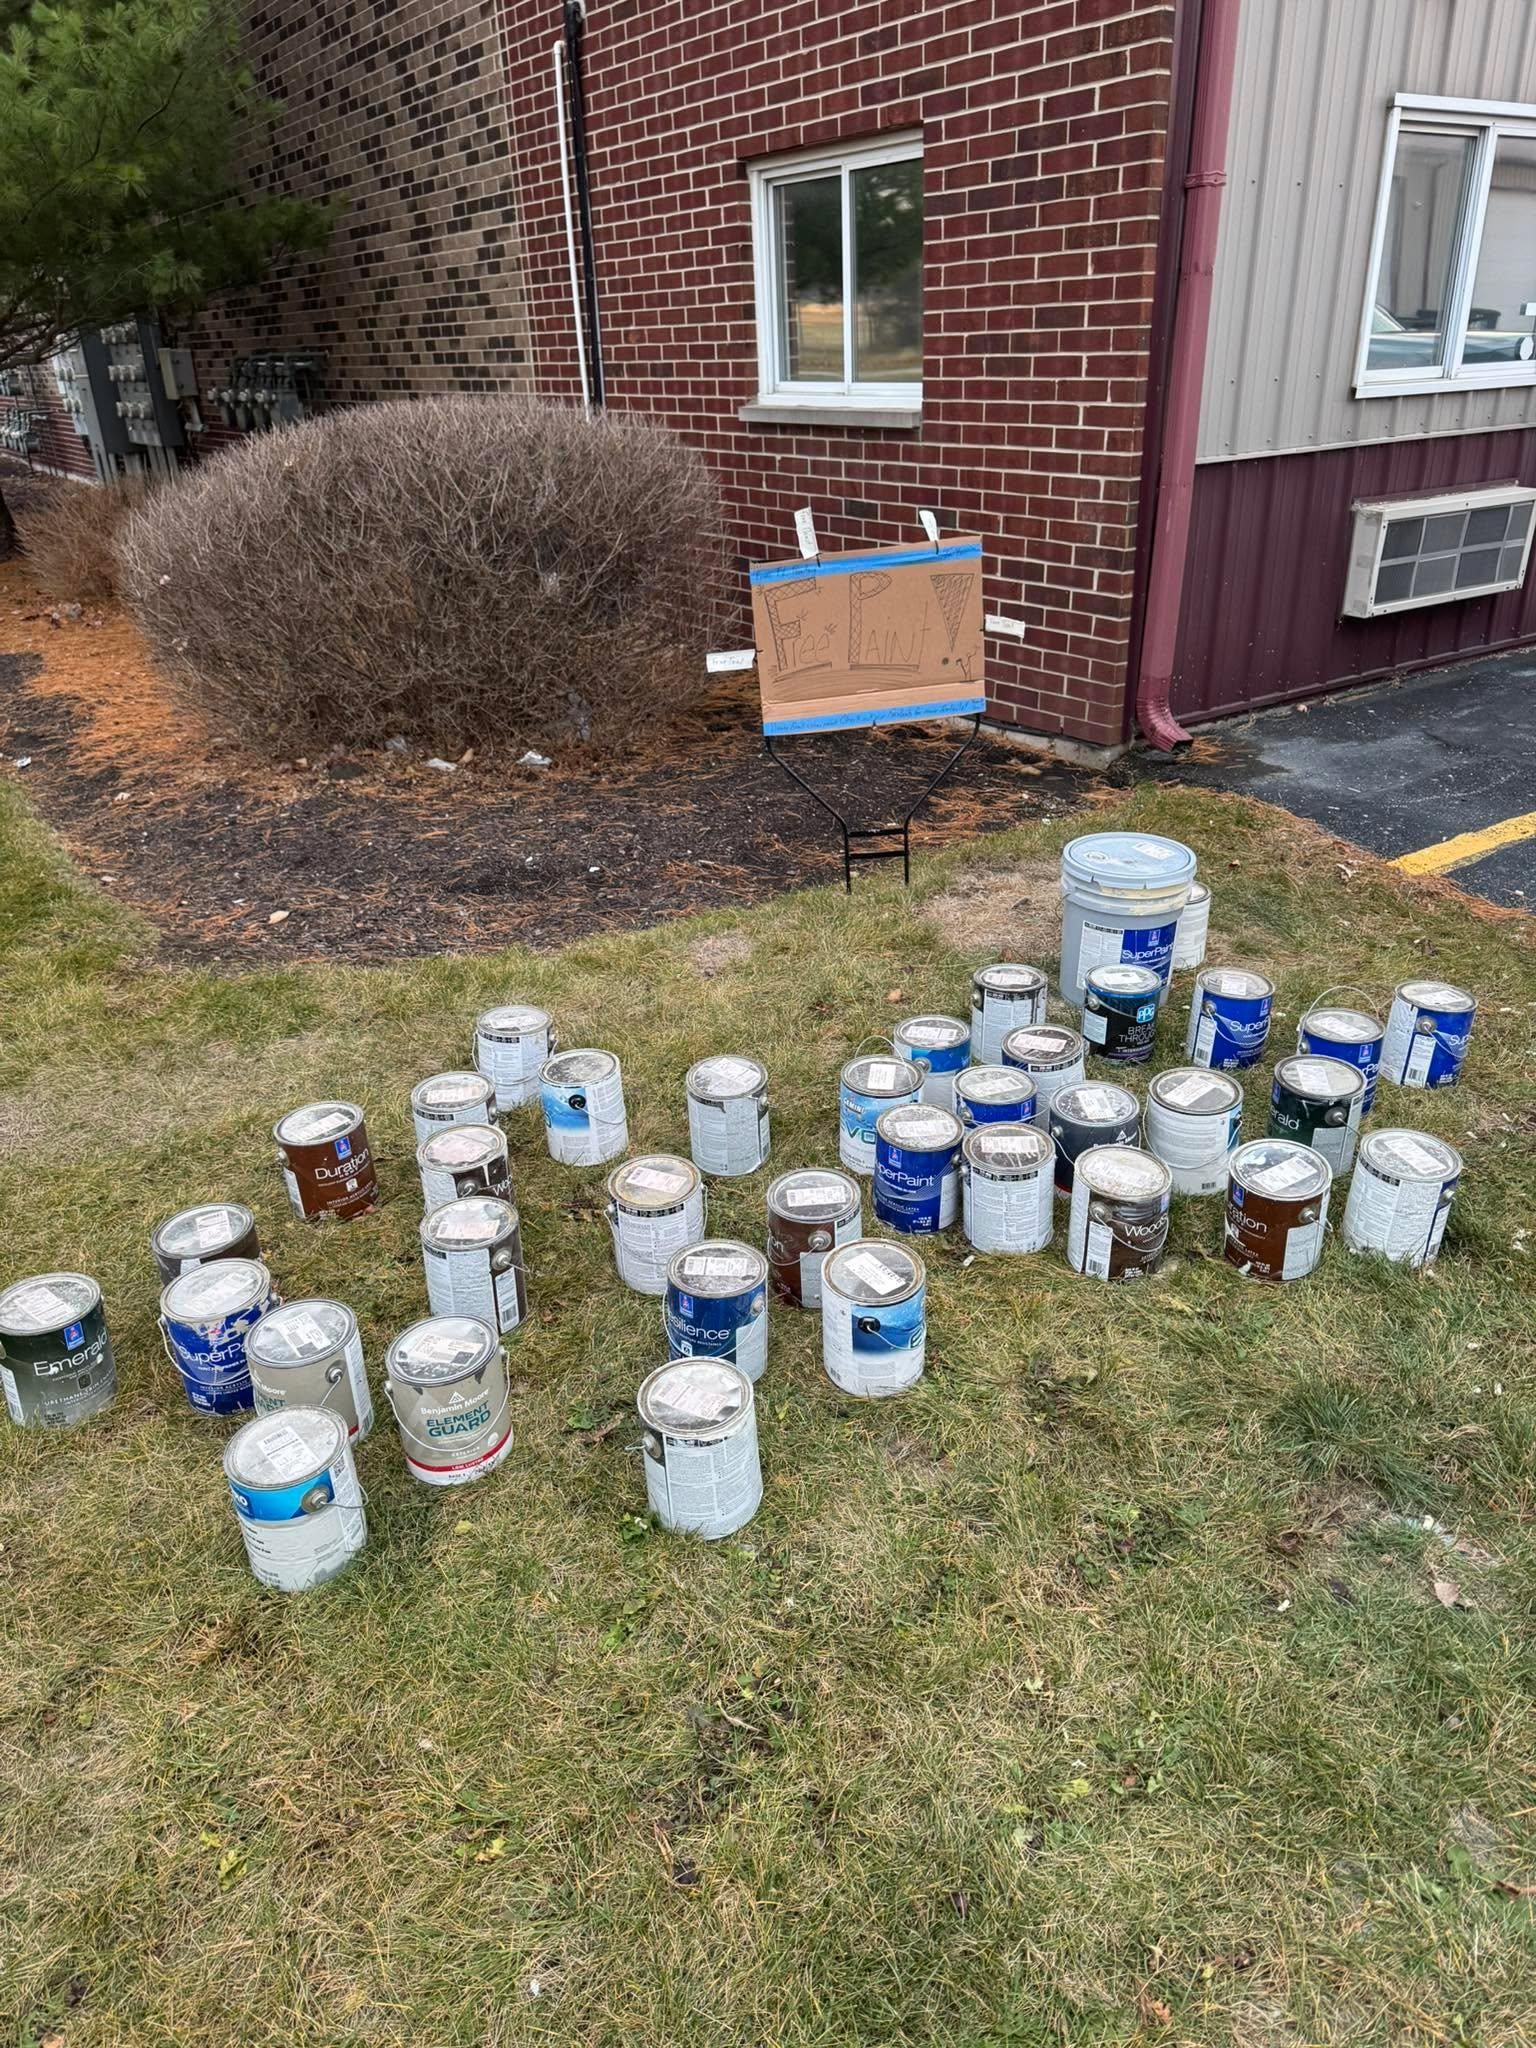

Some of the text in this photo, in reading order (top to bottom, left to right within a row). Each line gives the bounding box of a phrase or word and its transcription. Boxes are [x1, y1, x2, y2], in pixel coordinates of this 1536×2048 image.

[314, 1147, 370, 1180] Duration
[33, 1327, 108, 1377] Emerald
[420, 1387, 490, 1416] Benjamin Moore
[426, 1400, 490, 1428] ELEMENT
[428, 1409, 492, 1438] GUARD
